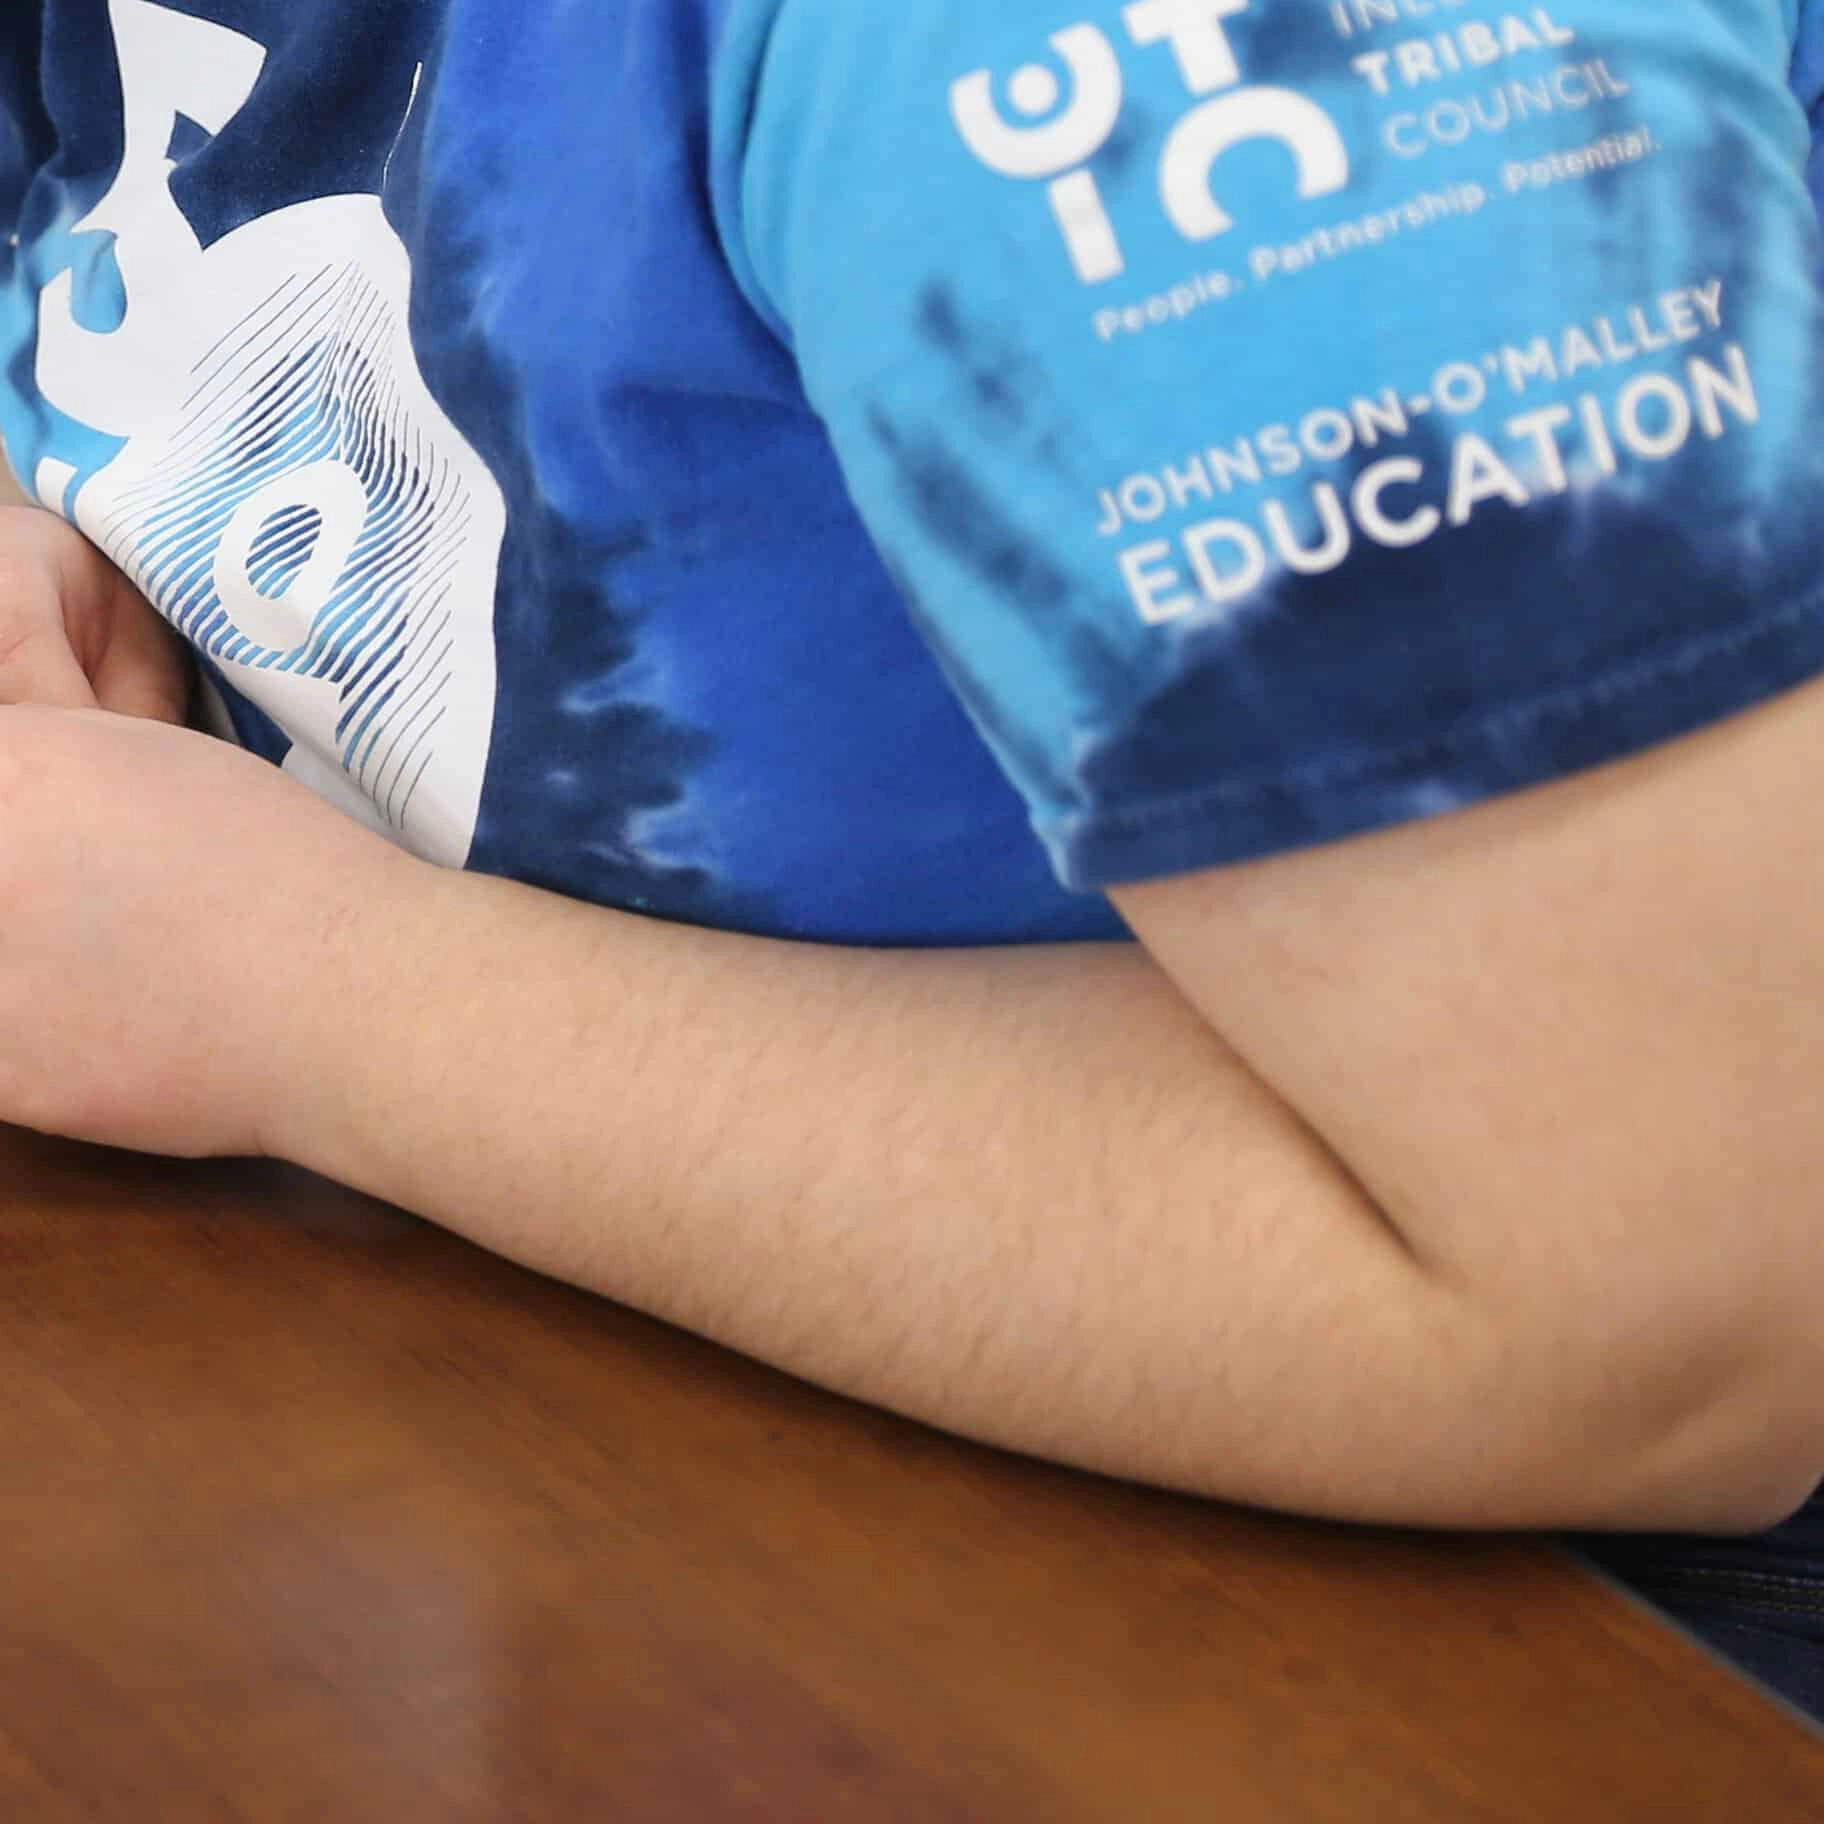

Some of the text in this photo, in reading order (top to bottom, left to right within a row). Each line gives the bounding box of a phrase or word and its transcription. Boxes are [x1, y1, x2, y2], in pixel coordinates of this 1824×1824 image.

[1353, 8, 1573, 96] TRIBAL
[1383, 59, 1632, 158] COUNCIL
[1093, 124, 1663, 342] People. Partnership. Potential.
[1095, 280, 1725, 537] JOHNSON-O'MALLEY
[1118, 345, 1759, 625] EDUCATION
